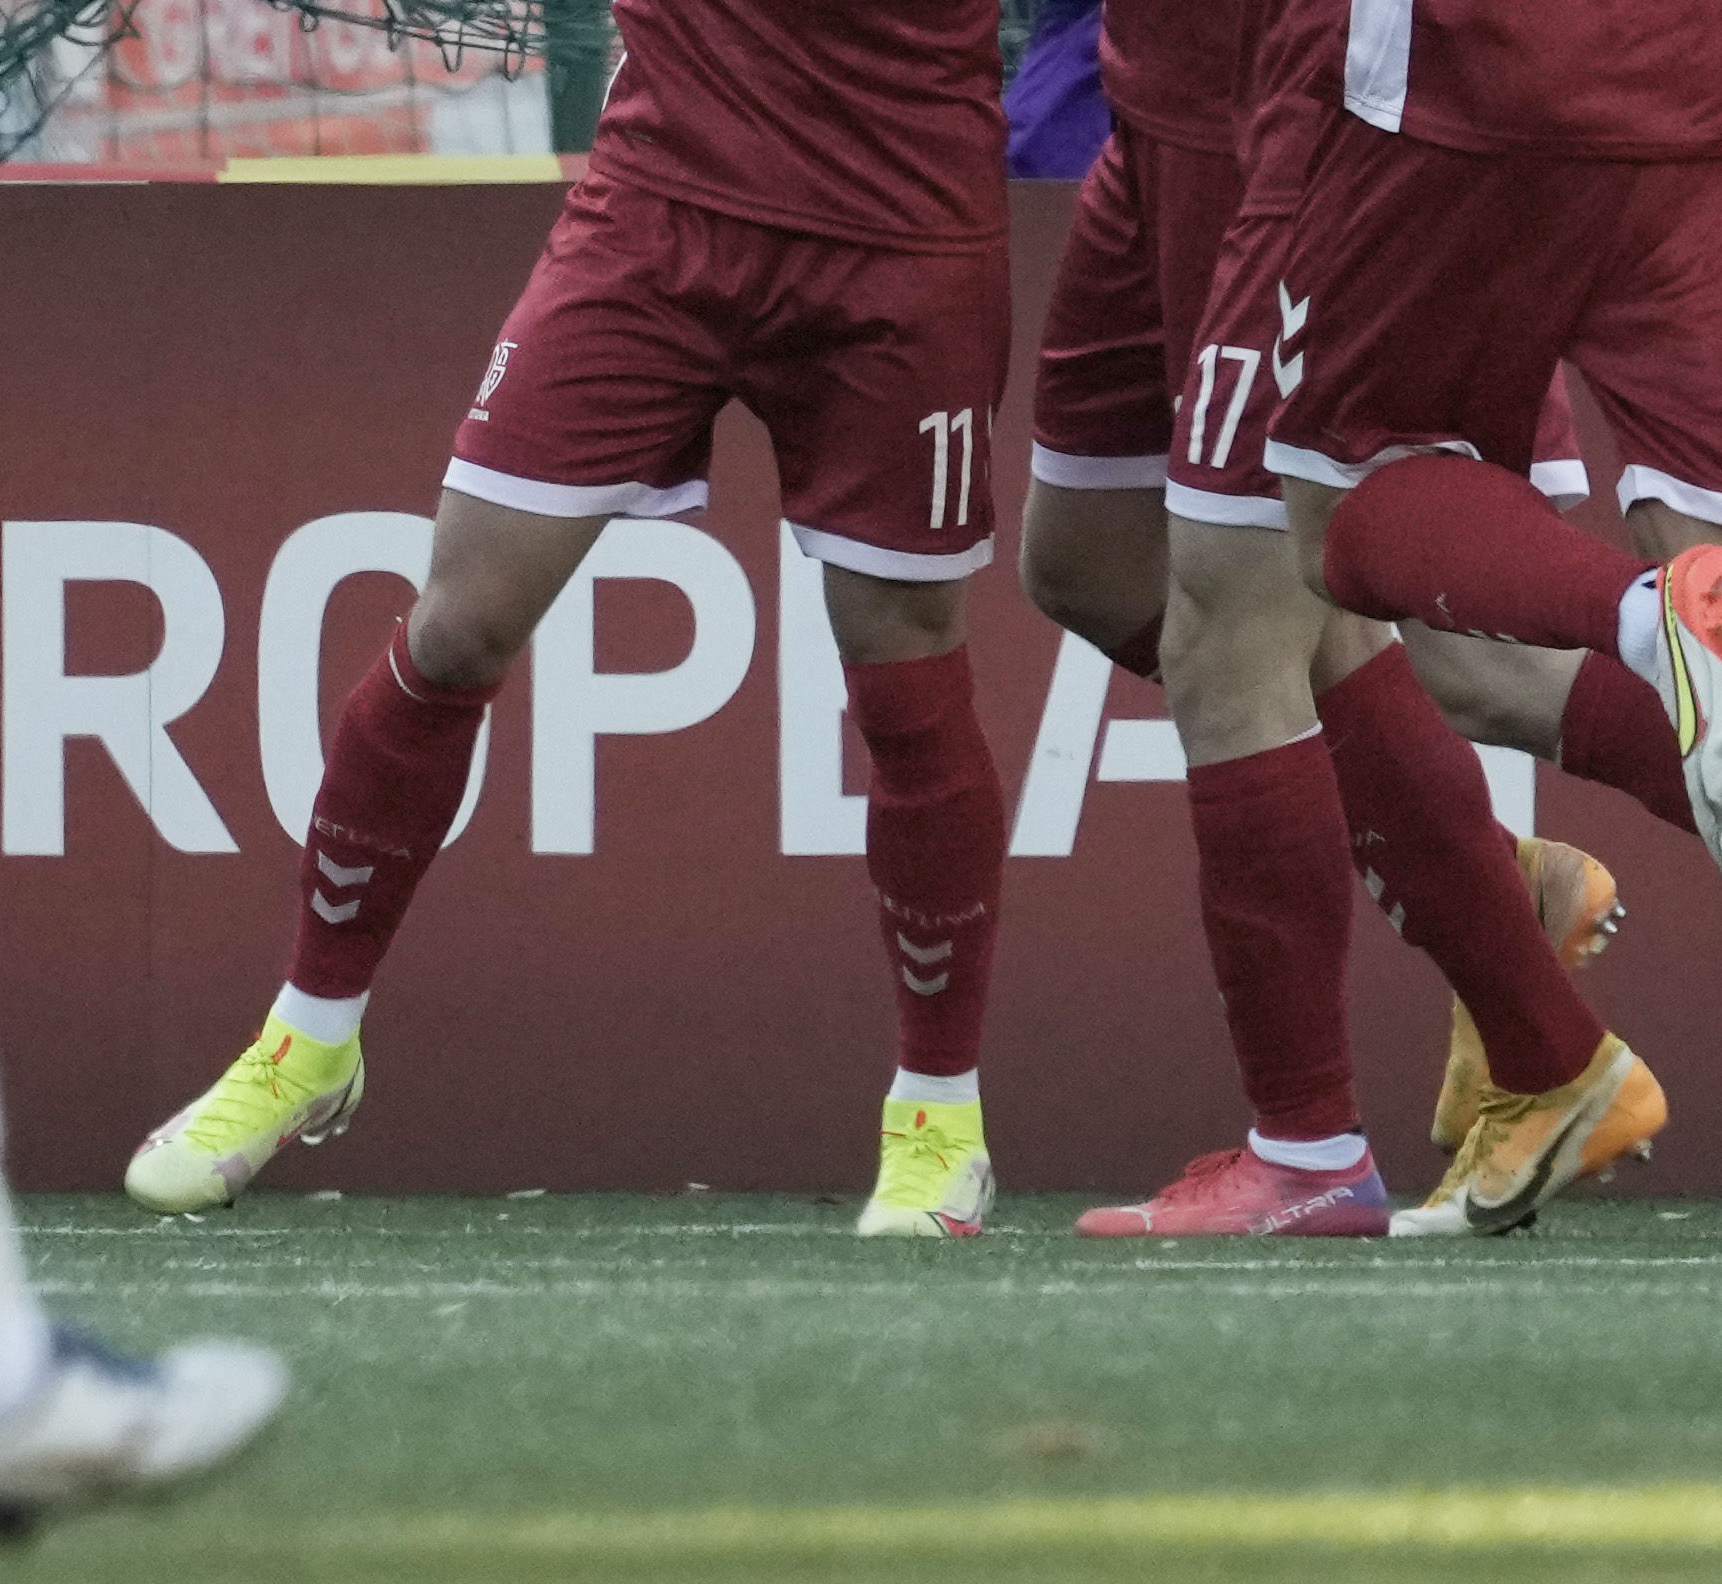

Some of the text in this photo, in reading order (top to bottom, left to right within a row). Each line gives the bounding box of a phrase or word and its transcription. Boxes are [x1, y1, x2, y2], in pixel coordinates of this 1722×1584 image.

[1186, 343, 1262, 469] 17
[918, 407, 974, 529] 11
[1245, 1185, 1355, 1236] ULTRA
